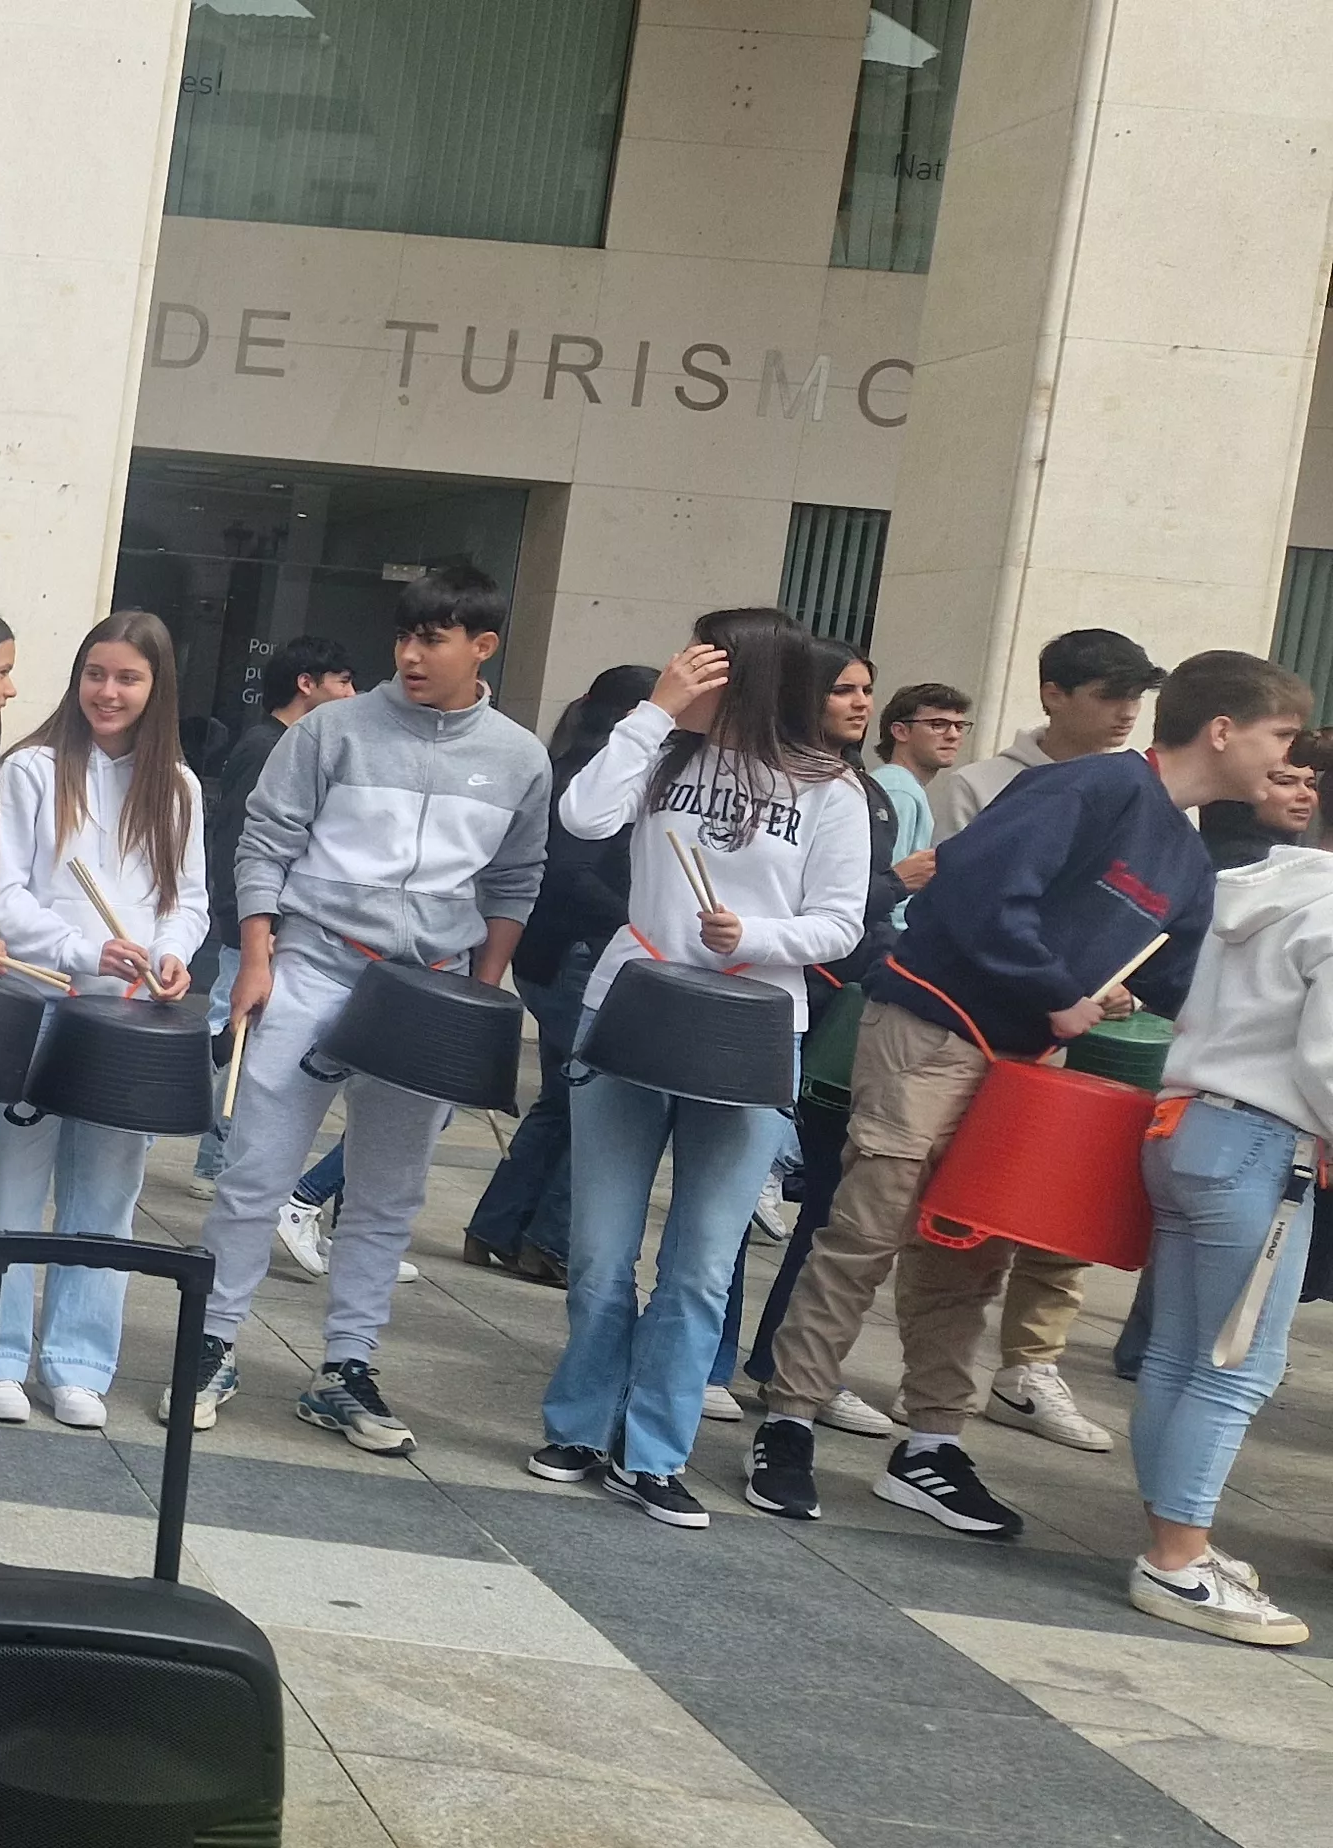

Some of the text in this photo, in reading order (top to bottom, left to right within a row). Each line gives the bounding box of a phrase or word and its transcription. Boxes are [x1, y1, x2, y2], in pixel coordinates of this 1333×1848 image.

[149, 301, 292, 378] DE
[385, 319, 915, 428] TURISMO
[651, 782, 802, 847] HOLLISTER
[1265, 1220, 1286, 1262] HEAD
